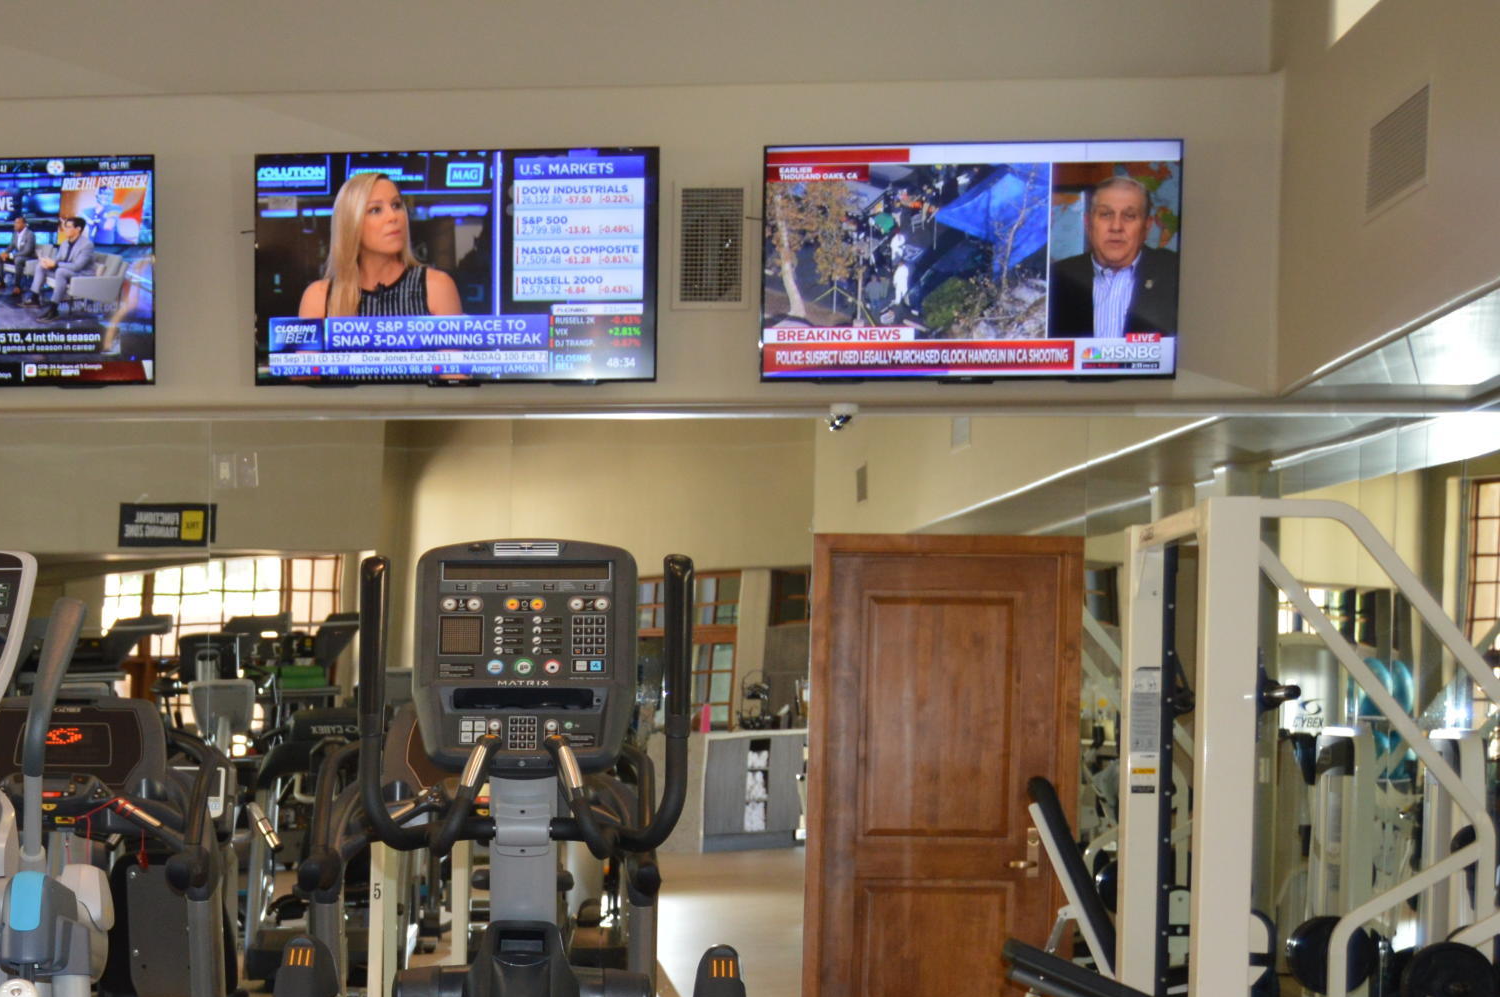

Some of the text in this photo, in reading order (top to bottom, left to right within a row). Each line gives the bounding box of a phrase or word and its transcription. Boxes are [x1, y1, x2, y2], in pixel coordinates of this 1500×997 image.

[451, 168, 479, 181] MAG
[519, 162, 614, 176] U.S. MARKETS
[778, 166, 813, 174] EARLIER
[61, 173, 149, 191] ROETHLISBERGER
[846, 172, 858, 180] CA
[521, 184, 629, 195] DOW INDUSTRIALS
[521, 215, 568, 225] S&P 500
[521, 244, 639, 256] NASDAQ COMPOSITE
[521, 275, 603, 285] RUSSELL 2000
[274, 324, 317, 334] CLOSING
[332, 319, 526, 334] DOW, S&P 500 ON PACE TO
[24, 332, 32, 343] 4
[33, 332, 47, 343] Int
[47, 331, 65, 343] this
[66, 333, 101, 343] season
[285, 332, 319, 344] BELL
[332, 332, 542, 347] SNAP 3-DAY WINNING STREAK
[776, 328, 901, 341] BREAKING NEWS
[1131, 334, 1155, 342] LIVE
[2, 345, 26, 354] games
[26, 344, 35, 352] of
[71, 344, 96, 352] career
[1100, 346, 1160, 360] MSNBC
[382, 354, 408, 362] Jones
[463, 352, 501, 361] NASDAQ
[503, 352, 519, 360] 100
[805, 350, 838, 365] SUSPECT
[838, 350, 859, 364] USED
[940, 350, 968, 363] GLOCK
[967, 349, 1007, 363] HANDGUN
[1006, 349, 1016, 362] IN
[1016, 349, 1028, 362] CA
[1028, 348, 1068, 362] SHOOTING
[283, 366, 311, 375] 207.74
[349, 366, 380, 375] Hasbro
[381, 366, 407, 375] (HAS)
[442, 365, 460, 373] 1.91
[470, 365, 501, 375] Amgen
[503, 364, 539, 374] (AMGN)
[1292, 715, 1325, 729] CYBEX
[373, 882, 382, 900] 5
